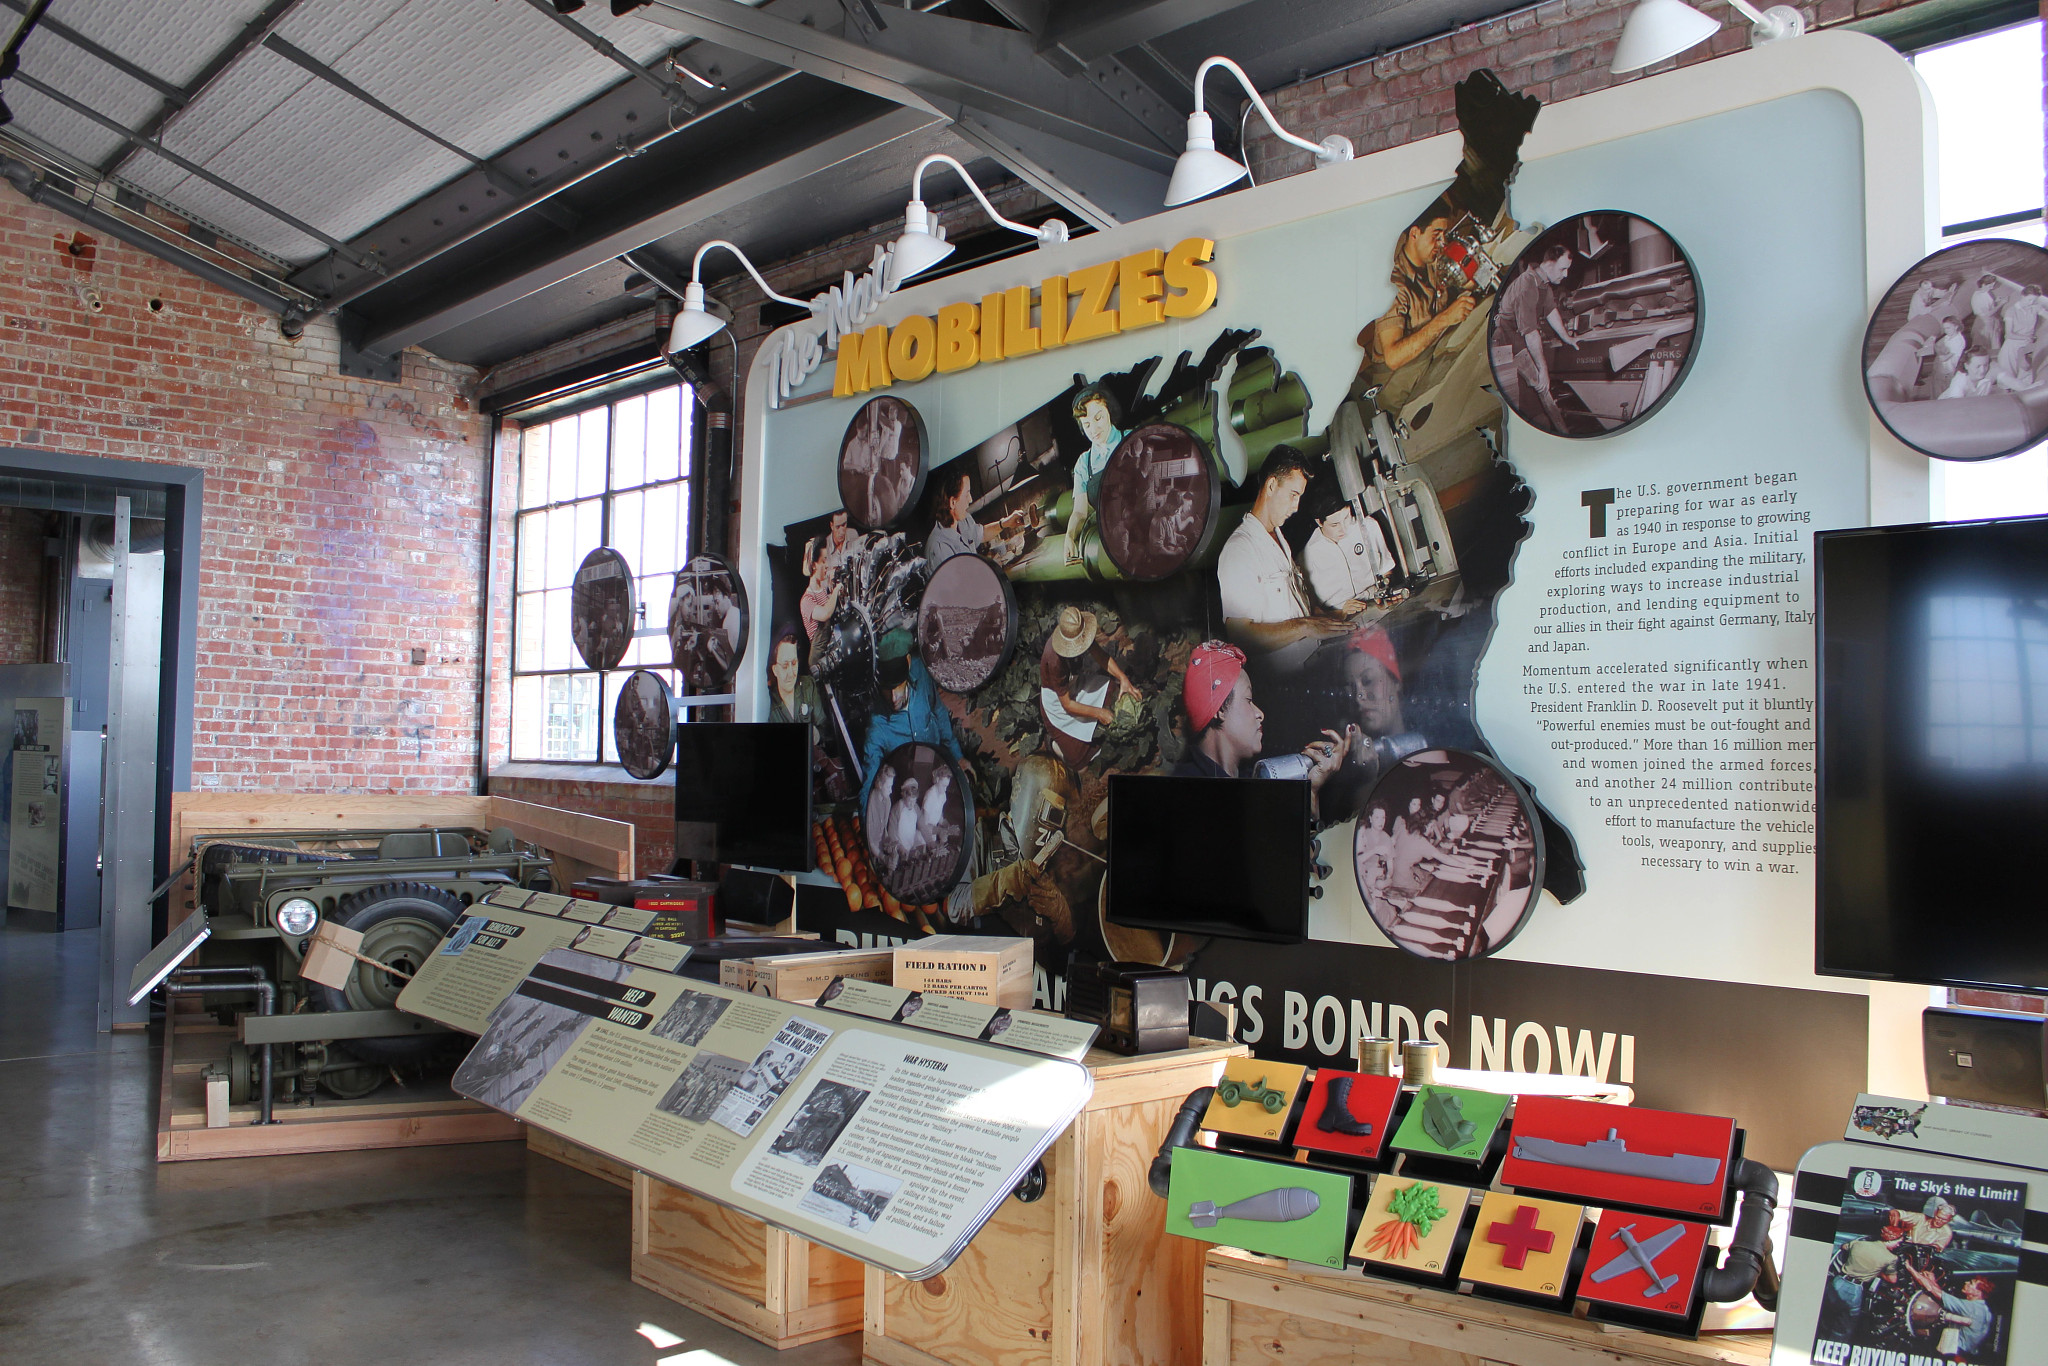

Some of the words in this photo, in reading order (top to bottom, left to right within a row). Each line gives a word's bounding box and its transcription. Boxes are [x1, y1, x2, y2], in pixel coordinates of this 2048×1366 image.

[833, 237, 1217, 398] MOBILIZES
[761, 328, 822, 409] The
[1637, 483, 1660, 497] U.S.
[1667, 475, 1748, 496] government
[1754, 472, 1798, 486] began
[1617, 502, 1679, 520] preparing
[1685, 499, 1703, 511] for
[1708, 498, 1735, 509] war
[1741, 496, 1755, 506] as
[1762, 490, 1798, 504] early
[1617, 527, 1629, 536] as
[1634, 521, 1661, 535] 1940
[1665, 521, 1678, 532] in
[1682, 518, 1736, 532] response
[1740, 515, 1753, 526] to
[1757, 510, 1811, 527] growing
[1563, 546, 1609, 559] conflict
[1614, 544, 1627, 555] in
[1632, 542, 1676, 554] Europe
[1682, 537, 1708, 550] and
[1713, 534, 1747, 548] Asia.
[1754, 529, 1798, 544] Initial
[1555, 566, 1590, 578] efforts
[1594, 561, 1647, 575] included
[1651, 557, 1718, 573] expanding
[1723, 554, 1744, 567] the
[1749, 551, 1806, 565] military,
[1547, 583, 1605, 599] exploring
[1610, 583, 1643, 595] ways
[1649, 580, 1661, 591] to
[1667, 575, 1722, 590] increase
[1728, 570, 1799, 586] industrial
[1540, 602, 1610, 618] production,
[1617, 599, 1641, 612] and
[1646, 597, 1697, 611] lending
[1704, 592, 1780, 609] equipment
[1786, 591, 1800, 603] to
[1534, 625, 1552, 634] our
[1556, 621, 1585, 633] allies
[1590, 620, 1602, 632] in
[1606, 619, 1634, 631] their
[1638, 617, 1666, 632] fight
[1670, 615, 1715, 631] against
[1719, 614, 1780, 627] Germany,
[1528, 641, 1549, 653] and
[1553, 641, 1589, 654] Japan.
[1523, 665, 1591, 676] Momentum
[1596, 661, 1668, 674] accelerated
[1674, 658, 1761, 675] significantly
[1766, 657, 1808, 669] when
[1523, 683, 1543, 695] the
[1549, 682, 1571, 694] U.S.
[1577, 681, 1626, 694] entered
[1632, 681, 1653, 693] the
[1659, 683, 1686, 692] war
[1691, 679, 1706, 691] in
[1712, 679, 1739, 691] late
[1746, 678, 1786, 690] 1941.
[1531, 701, 1583, 713] President
[1587, 700, 1637, 712] Franklin
[1641, 700, 1652, 711] D.
[1658, 699, 1718, 711] Roosevelt
[1722, 699, 1745, 713] put
[1749, 698, 1759, 710] it
[1764, 697, 1814, 712] bluntly
[1600, 719, 1650, 731] enemies
[1655, 720, 1686, 731] must
[1690, 719, 1705, 731] be
[1711, 718, 1780, 734] out-fought
[1785, 718, 1811, 730] and
[1644, 738, 1673, 750] More
[1677, 738, 1708, 750] than
[1713, 738, 1728, 751] 16
[1733, 738, 1783, 751] million
[1562, 757, 1586, 769] and
[1591, 760, 1638, 769] women
[1643, 758, 1686, 772] joined
[1691, 758, 1713, 770] the
[1720, 758, 1765, 771] armed
[1575, 776, 1599, 788] and
[1605, 777, 1655, 789] another
[1661, 777, 1676, 789] 24
[1682, 778, 1733, 790] million
[1739, 779, 1816, 792] contribute
[1589, 796, 1601, 807] to
[1607, 798, 1623, 807] an
[1628, 797, 1728, 811] unprecedented
[1735, 799, 1816, 812] nationwide
[1605, 814, 1636, 827] effort
[1640, 816, 1652, 827] to
[1656, 817, 1735, 831] manufacture
[1740, 819, 1761, 832] the
[1622, 835, 1654, 849] tools,
[1659, 839, 1726, 853] weaponry,
[1732, 839, 1757, 852] and
[1641, 857, 1702, 871] necessary
[1707, 858, 1719, 870] to
[1724, 861, 1750, 871] win
[1756, 863, 1763, 872] a
[1768, 863, 1799, 874] war.
[905, 961, 934, 970] FIELD
[938, 962, 976, 971] RATION
[980, 964, 987, 972] D
[622, 988, 646, 1003] HELP
[607, 1006, 643, 1026] WANTED
[774, 1030, 791, 1044] TAKE
[785, 1020, 806, 1035] SHOULD
[800, 1026, 818, 1040] YOUR
[811, 1031, 828, 1044] WIFE
[1283, 990, 1451, 1070] BONDS
[1470, 1014, 1636, 1085] NOW!
[902, 1054, 919, 1065] WAR
[917, 1057, 949, 1072] HYSTERIA
[1894, 1177, 1917, 1191] The
[1920, 1180, 1951, 1196] Sky's
[1954, 1184, 1976, 1197] the
[1979, 1186, 2019, 1202] Limit!
[1813, 1338, 1850, 1365] KEEP
[1851, 1345, 1906, 1366] BUYING
